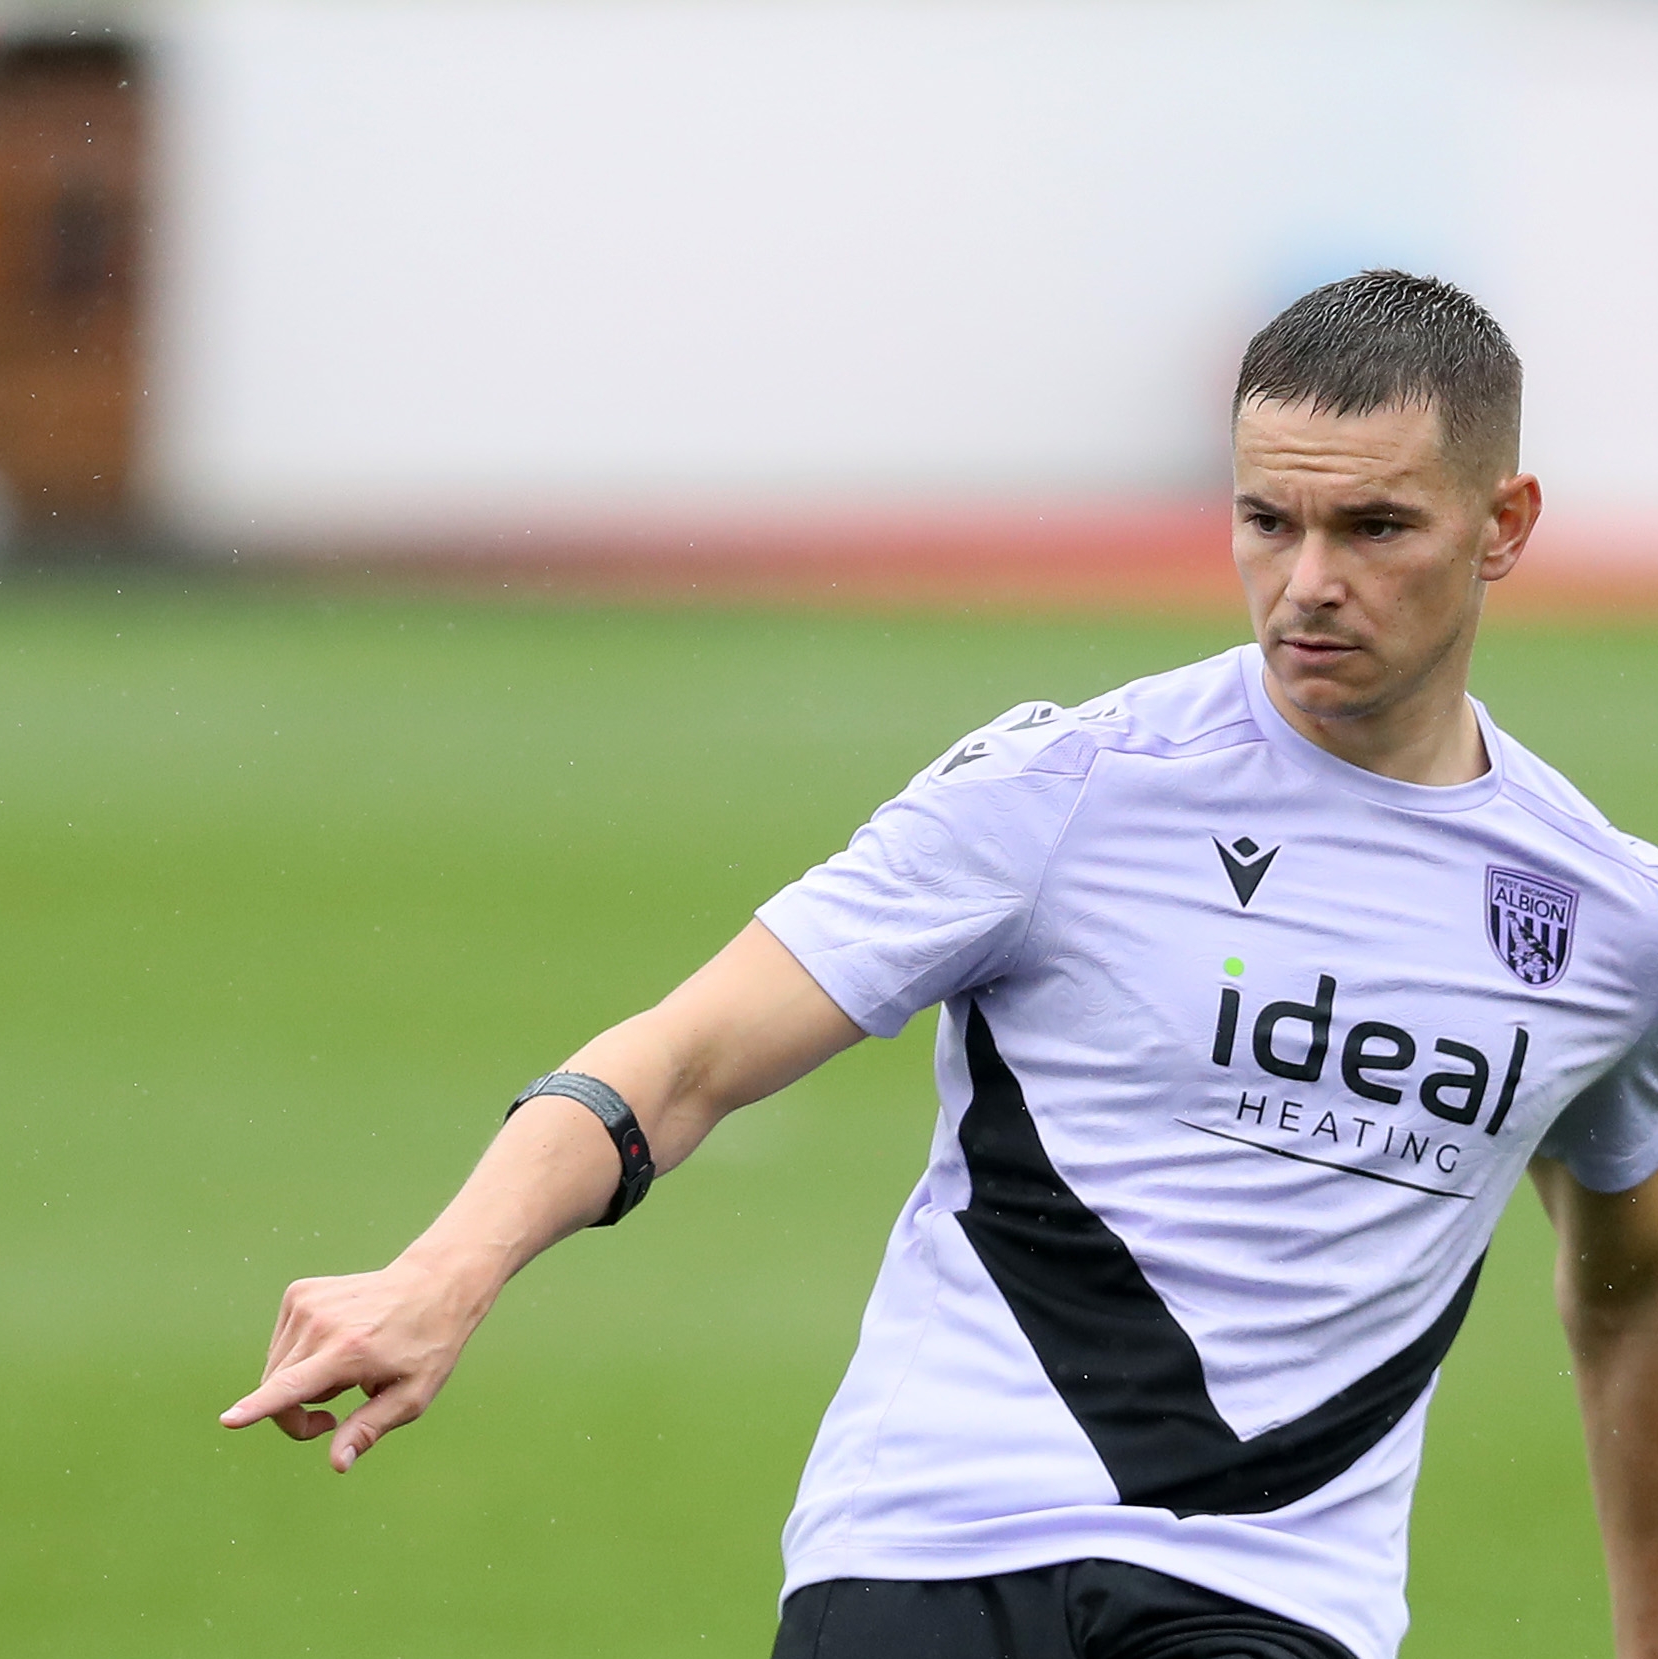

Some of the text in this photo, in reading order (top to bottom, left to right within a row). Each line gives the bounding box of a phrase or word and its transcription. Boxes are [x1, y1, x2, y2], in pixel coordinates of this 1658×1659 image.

[1495, 886, 1566, 924] ALBION
[1212, 956, 1529, 1136] ideal
[1236, 1090, 1461, 1174] HEATING
